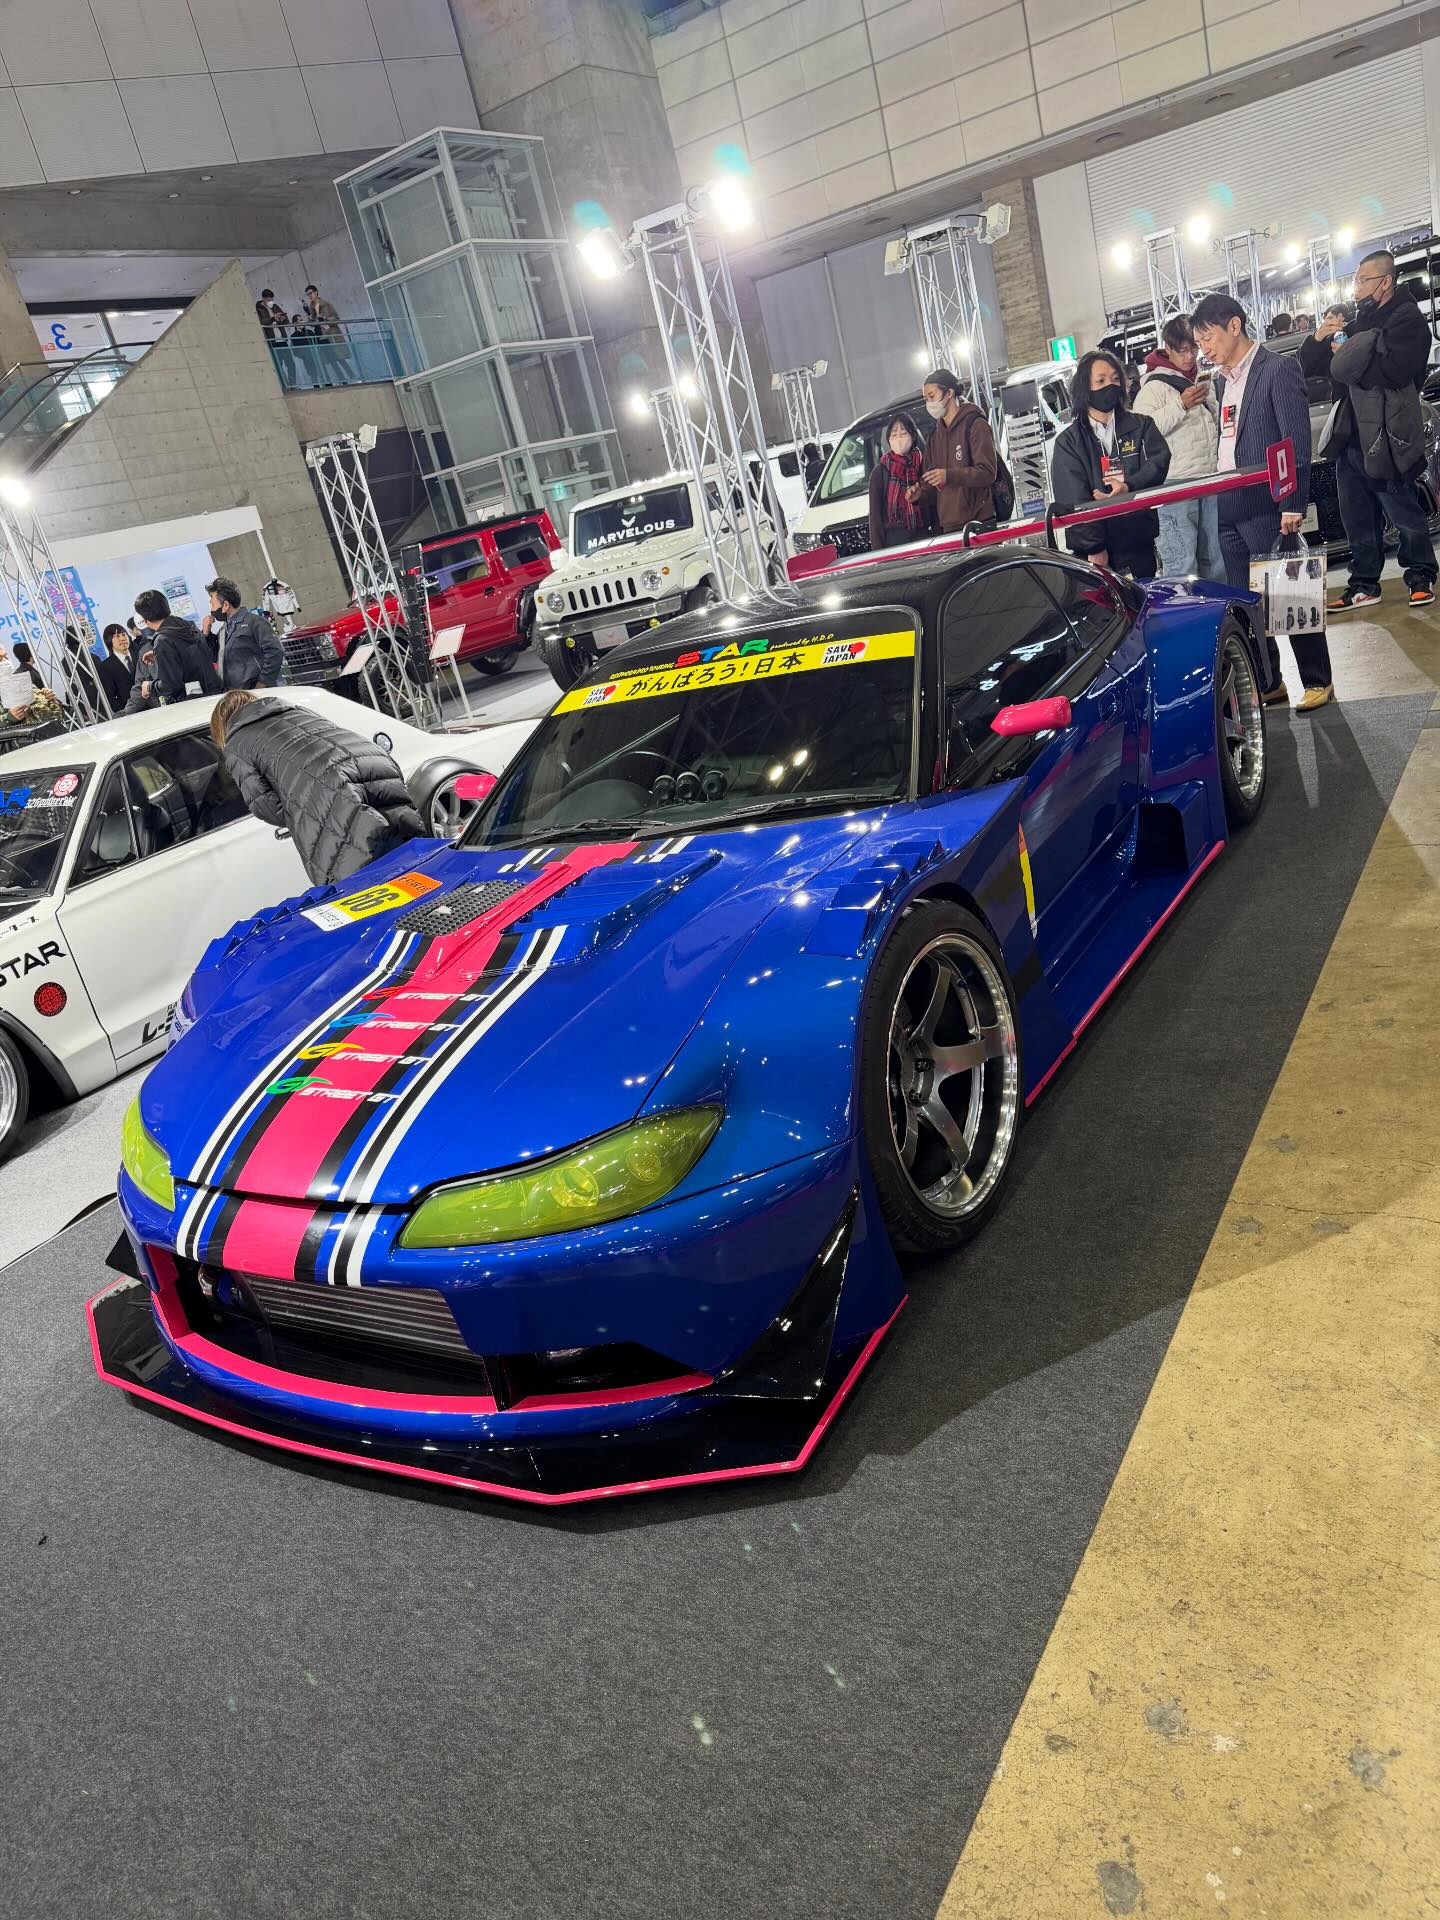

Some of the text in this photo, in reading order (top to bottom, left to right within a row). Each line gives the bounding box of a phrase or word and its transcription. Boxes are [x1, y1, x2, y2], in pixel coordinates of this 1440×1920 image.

[587, 519, 675, 550] MARVELOUS
[674, 639, 770, 668] STAR
[826, 643, 855, 655] SAVE
[823, 652, 857, 664] JAPAN
[394, 992, 492, 1002] STREET GT
[362, 1021, 462, 1031] STREET GT
[330, 1052, 432, 1065] STREET GT
[299, 1087, 401, 1103] STREET GT
